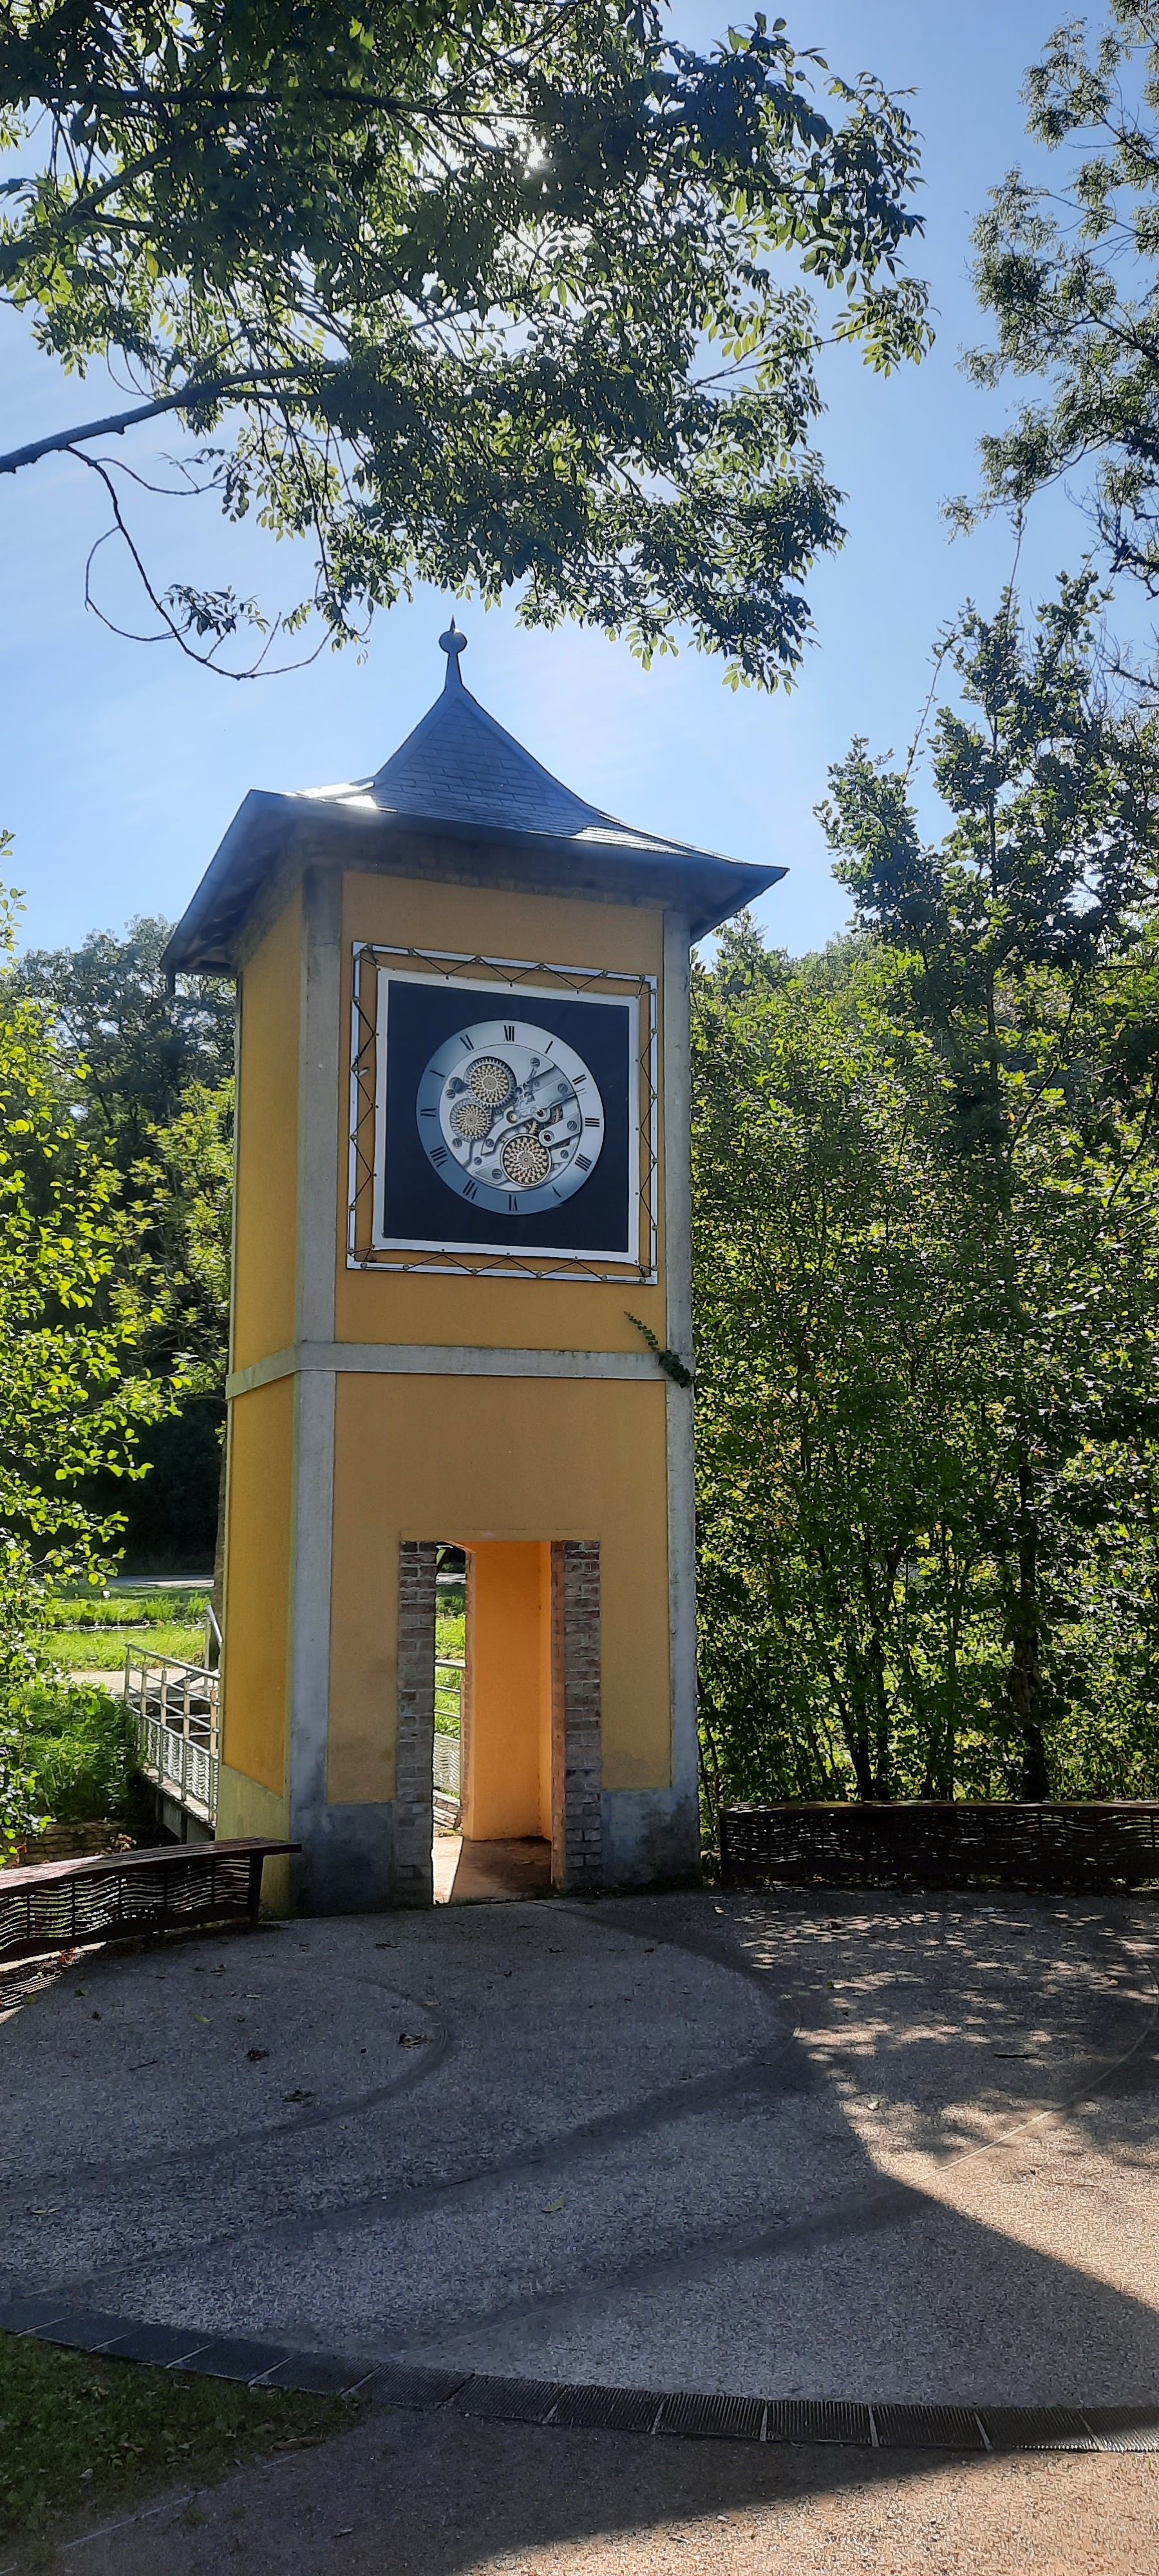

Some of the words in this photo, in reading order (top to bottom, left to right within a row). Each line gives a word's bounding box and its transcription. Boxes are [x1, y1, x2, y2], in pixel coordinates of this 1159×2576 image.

[504, 1025, 514, 1041] XII
[572, 1074, 587, 1085] II
[585, 1118, 599, 1127] III
[462, 1180, 478, 1200] VII
[509, 1195, 519, 1211] VI
